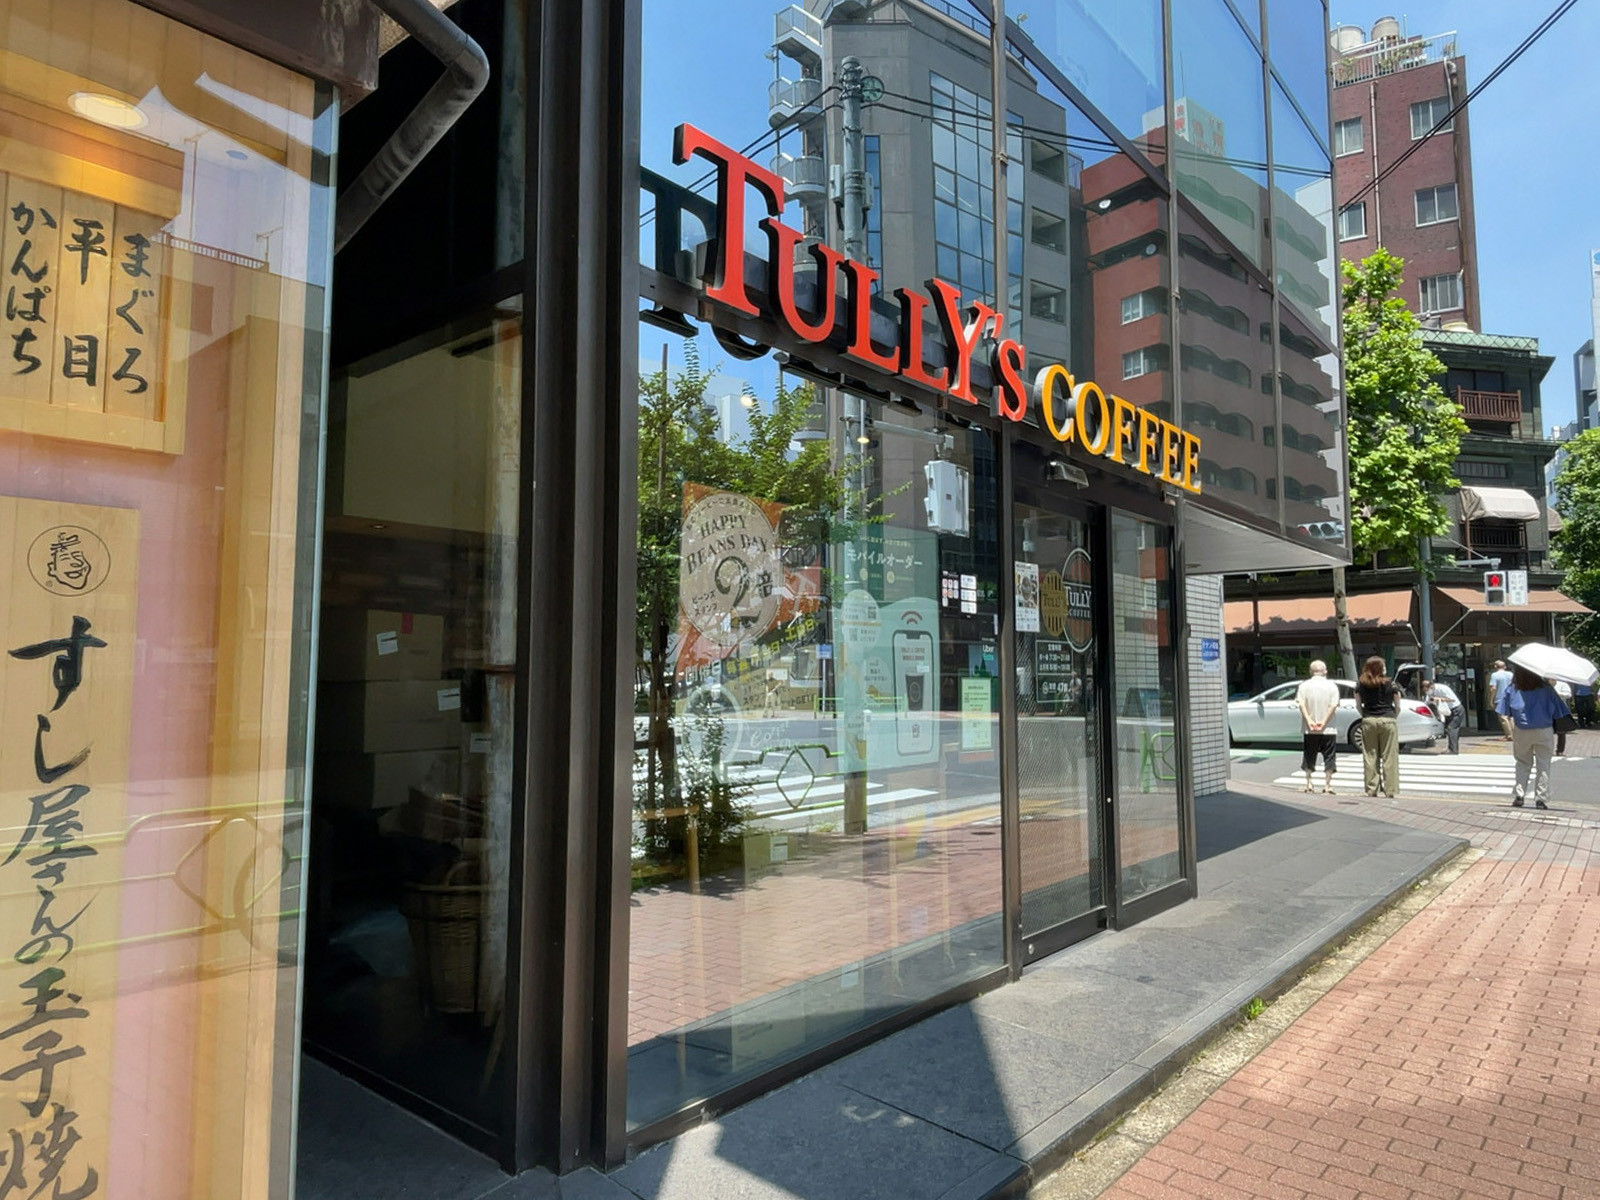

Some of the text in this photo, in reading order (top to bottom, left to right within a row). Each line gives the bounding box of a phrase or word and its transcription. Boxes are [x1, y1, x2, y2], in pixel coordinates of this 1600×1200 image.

[5, 200, 58, 376] かんぱち
[62, 218, 109, 387] 平目
[112, 232, 156, 394] まぐろ
[672, 122, 1201, 494] TULLY'S COFFEE
[686, 534, 736, 575] BEANS
[699, 514, 747, 539] HAPPY
[847, 548, 923, 569] モバイルオーダー
